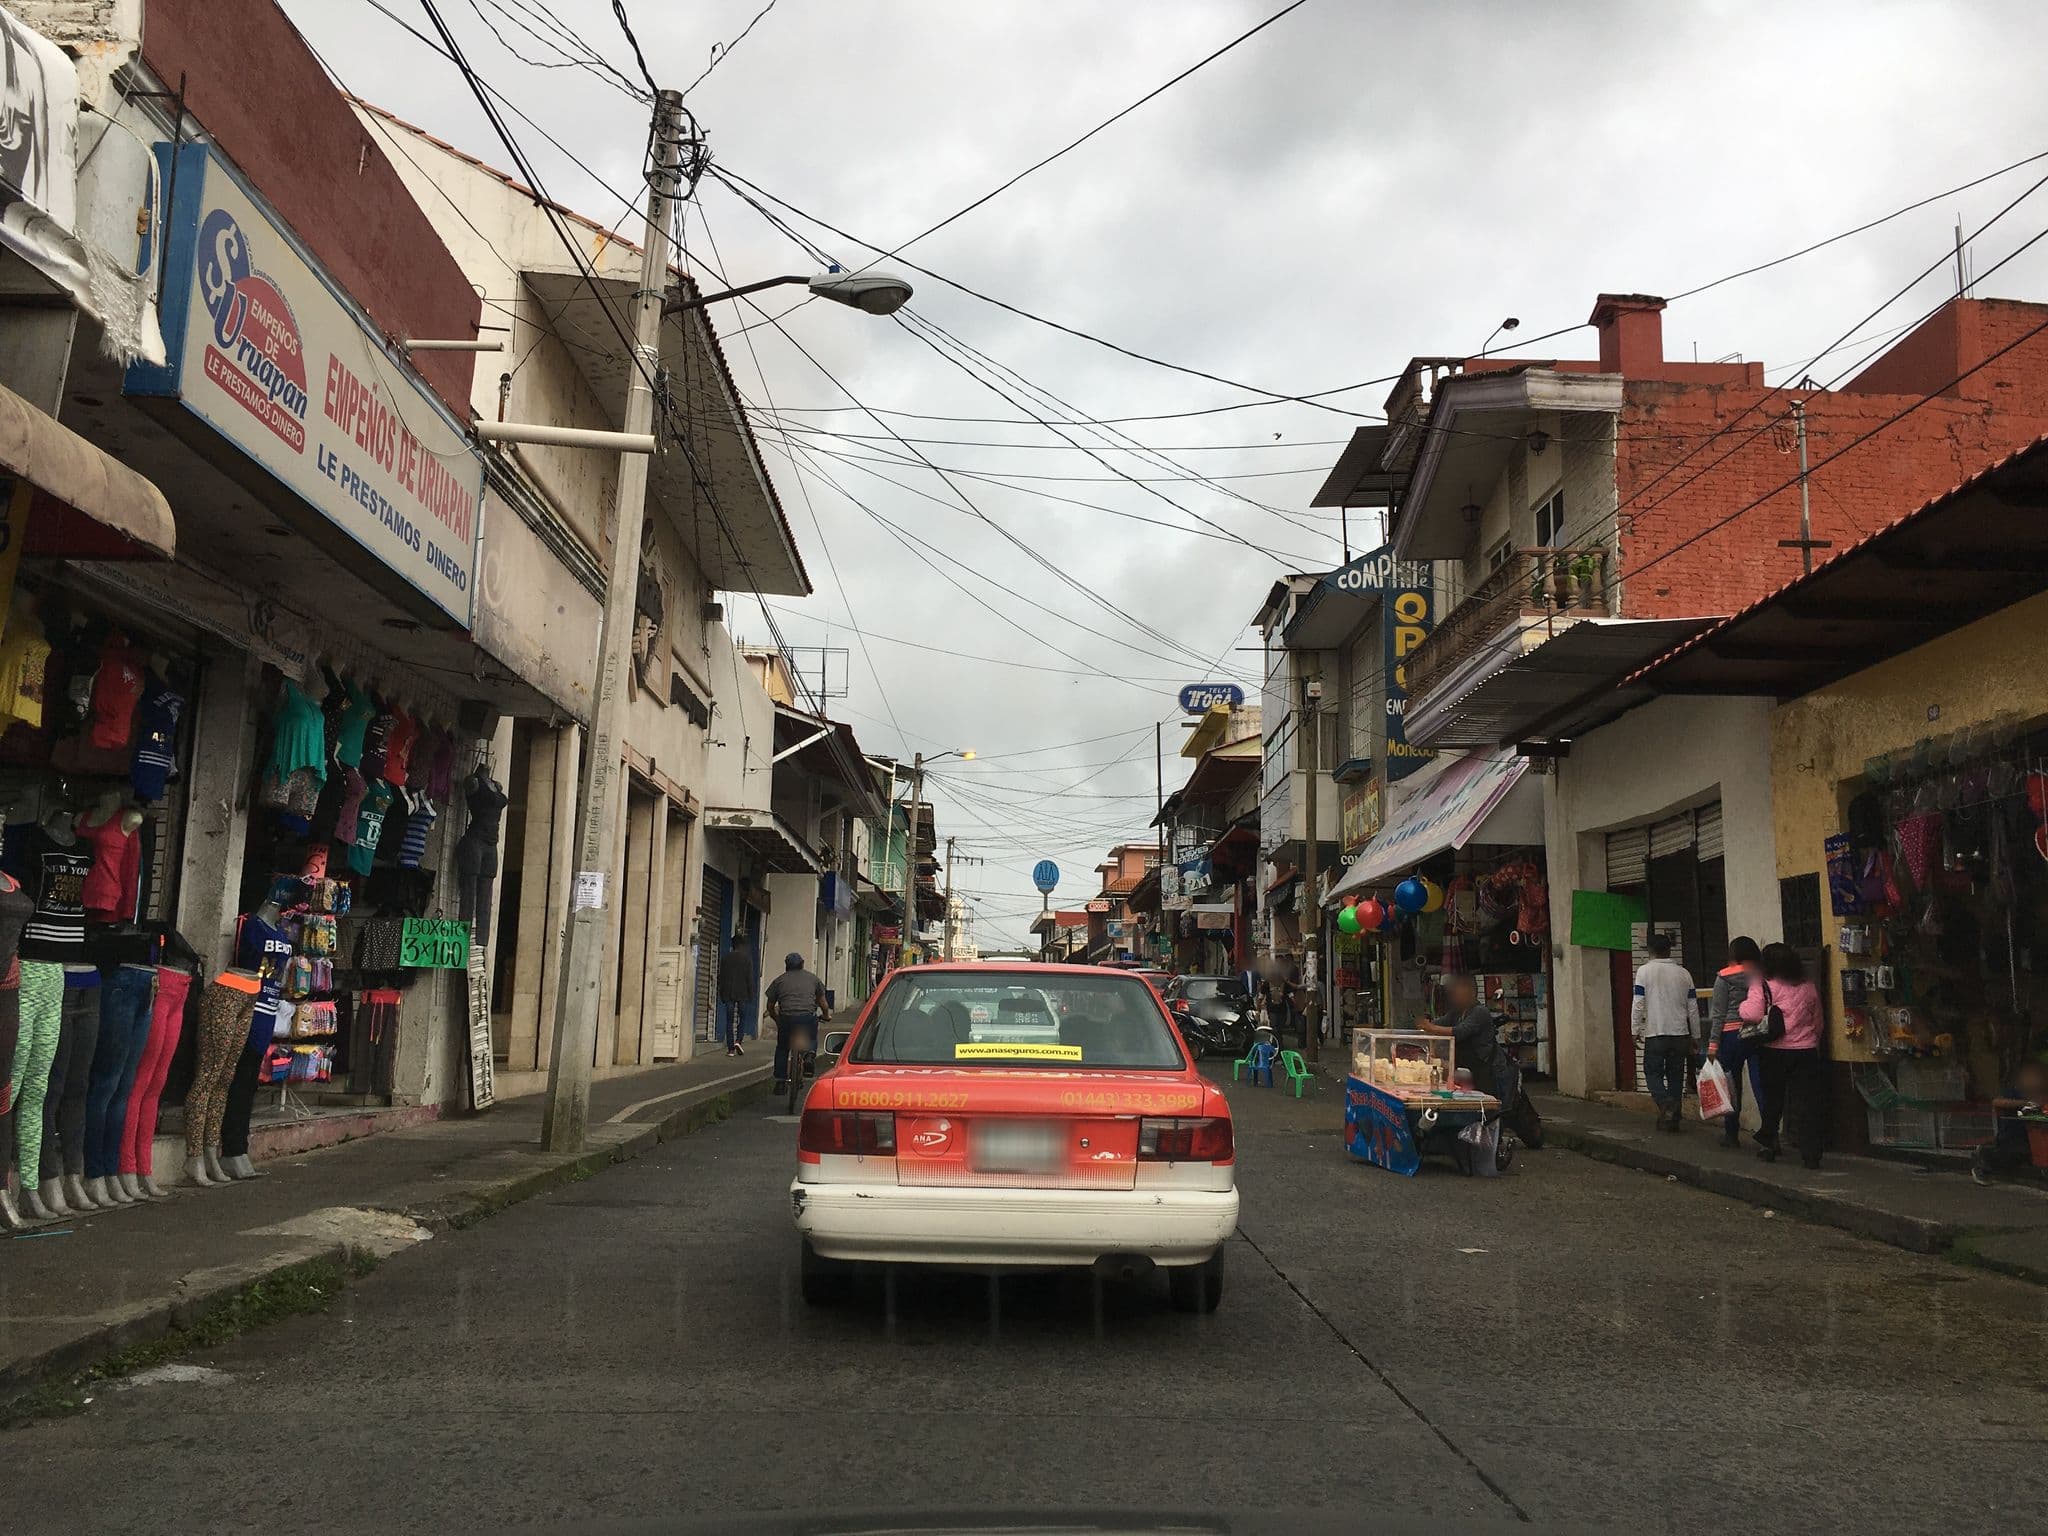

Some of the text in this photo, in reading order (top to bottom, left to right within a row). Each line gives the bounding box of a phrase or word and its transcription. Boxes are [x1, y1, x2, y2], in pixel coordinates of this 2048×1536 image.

[250, 298, 299, 355] EMPEÑOS
[264, 335, 280, 362] DE
[207, 354, 303, 447] LE PRESTAMOS DINERO
[323, 352, 474, 546] EMPEÑOS DE URUAPAN
[316, 442, 468, 592] LE PRESTAMOS DINERO
[958, 1046, 1080, 1058] www.anaseguros.com.mx
[912, 1134, 932, 1143] ANA
